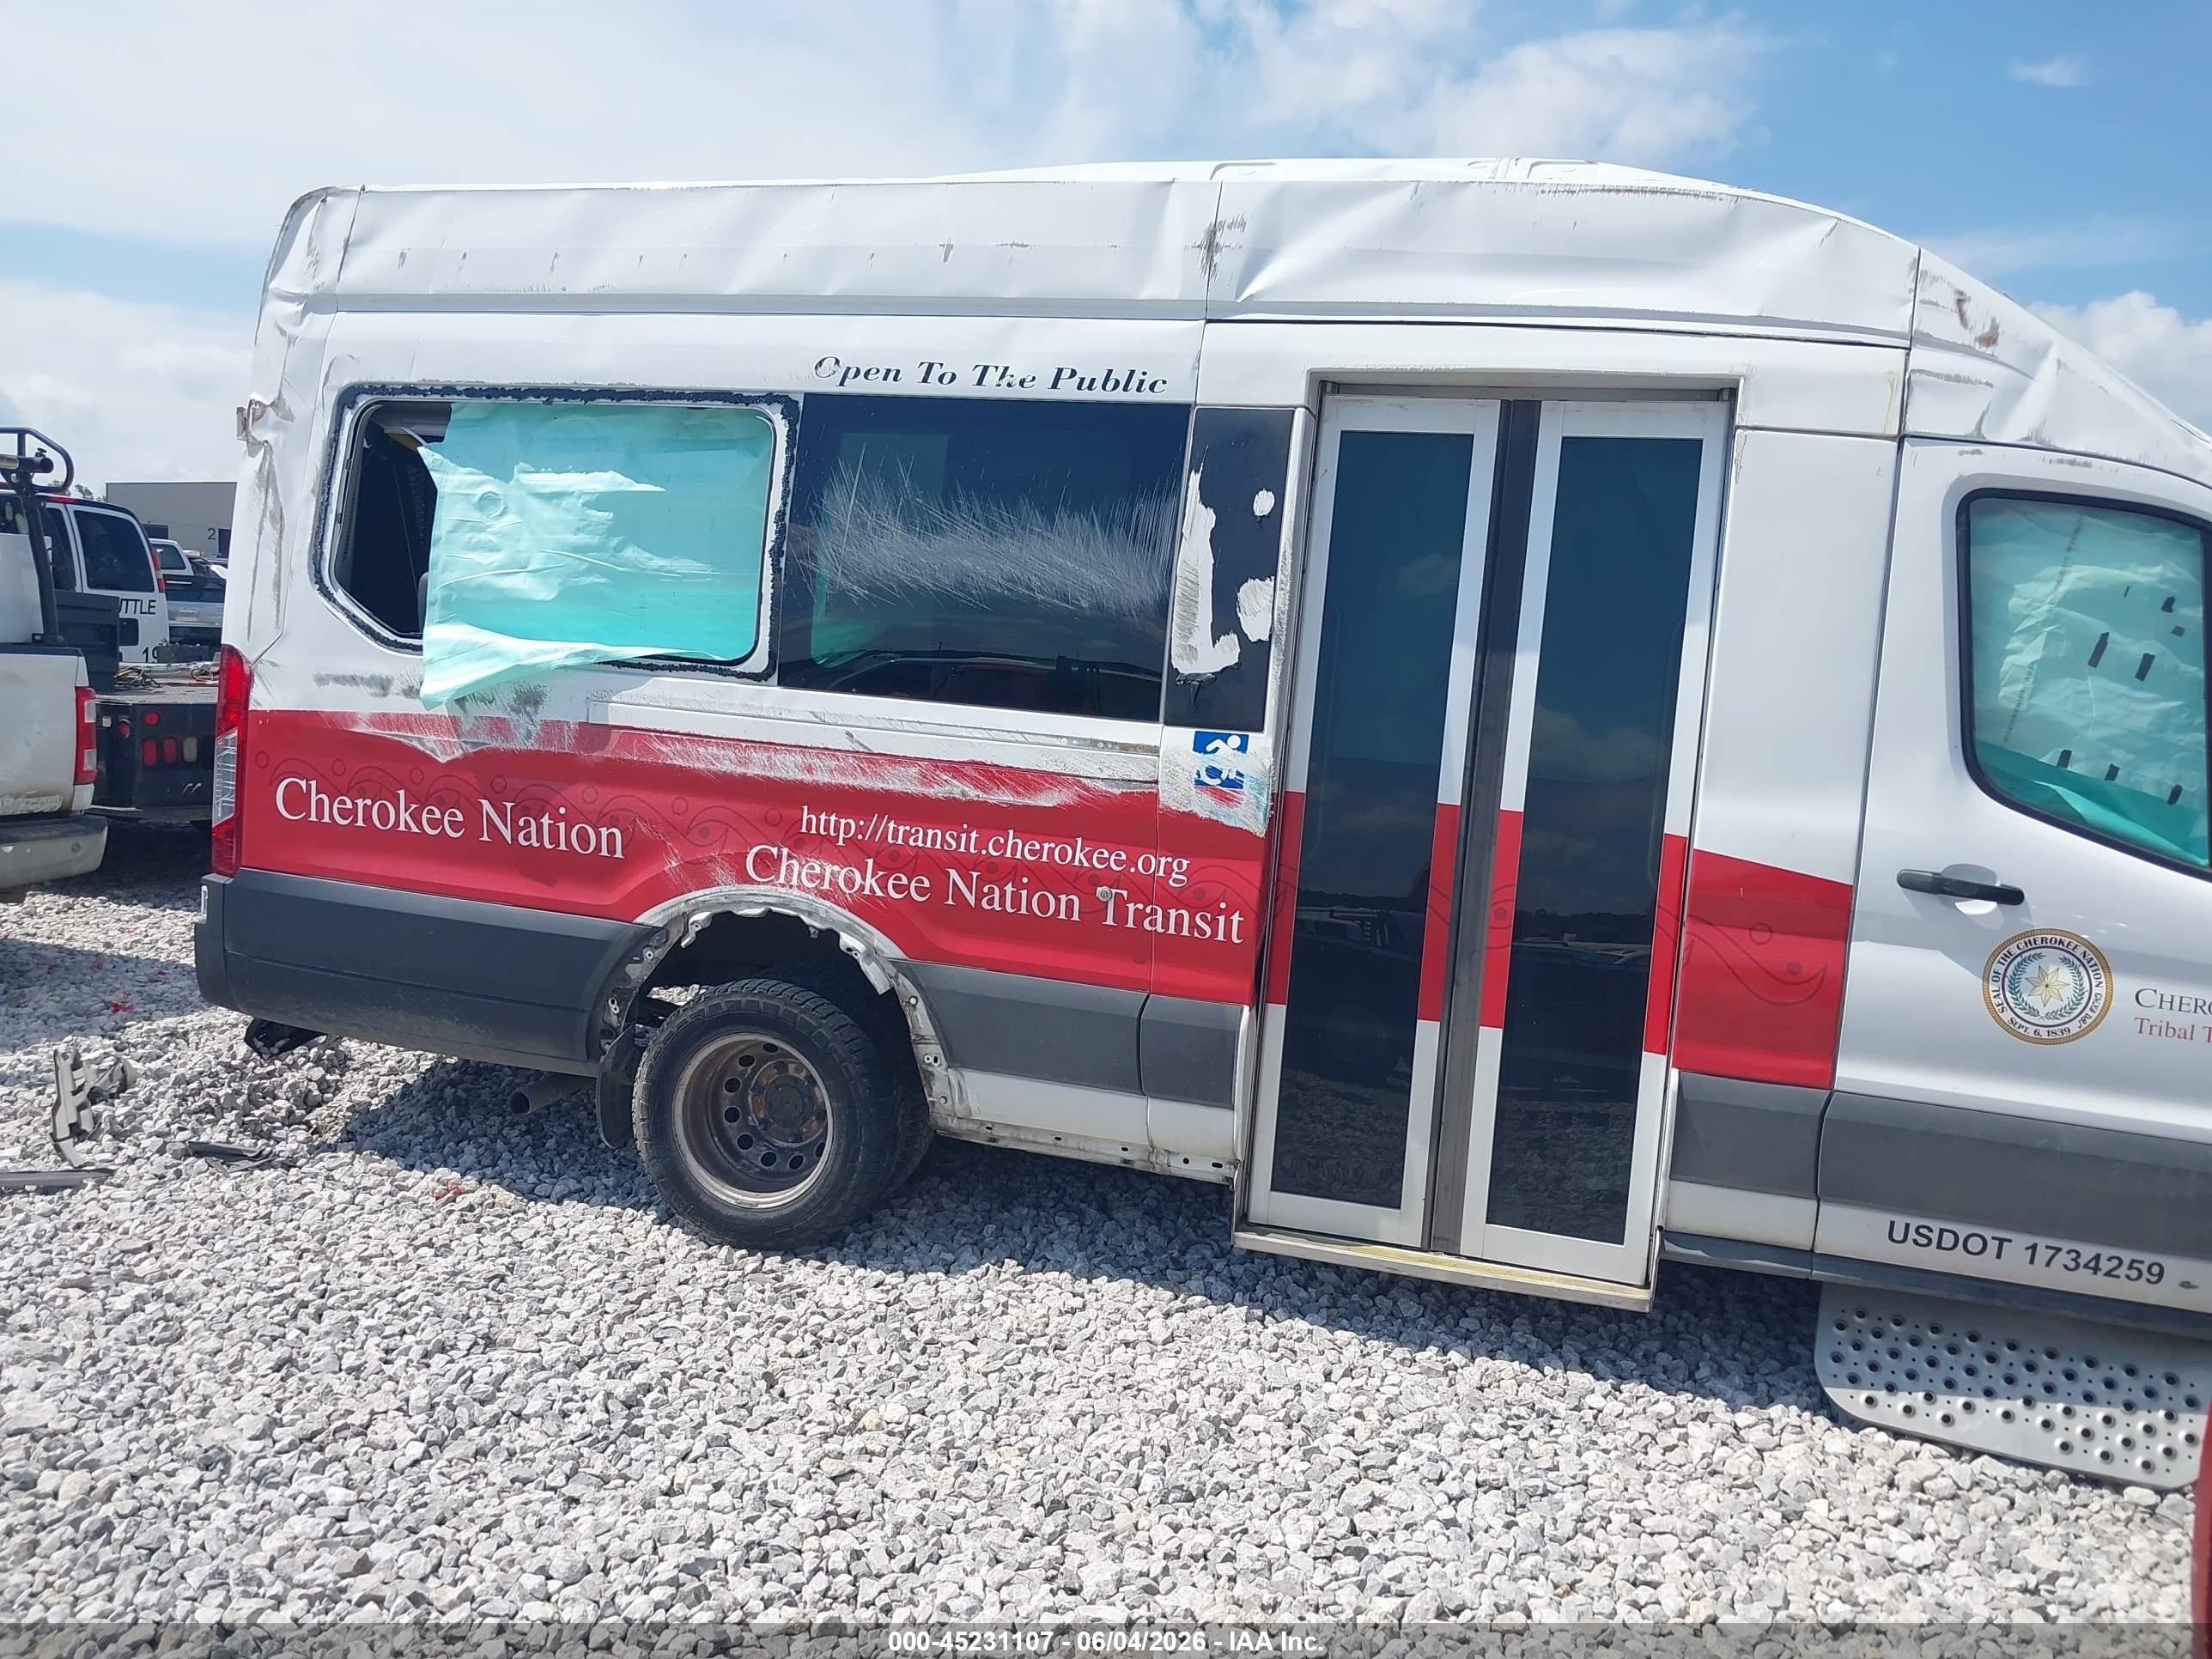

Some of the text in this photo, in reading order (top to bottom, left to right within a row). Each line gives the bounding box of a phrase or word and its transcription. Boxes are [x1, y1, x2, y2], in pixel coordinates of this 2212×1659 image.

[814, 356, 1168, 394] Open To The Public
[207, 527, 216, 540] 2
[275, 777, 626, 860] Cherokee Nation
[799, 805, 1190, 887] http://transit.cherokee.org
[745, 844, 1245, 944] Cherokee Nation Transit
[1991, 936, 2104, 1014] SEAL OF THE CHEROKEE NATION
[2046, 1026, 2071, 1037] 1839
[2135, 1017, 2196, 1041] Tribal
[1888, 1219, 2165, 1285] USDOT 1734259
